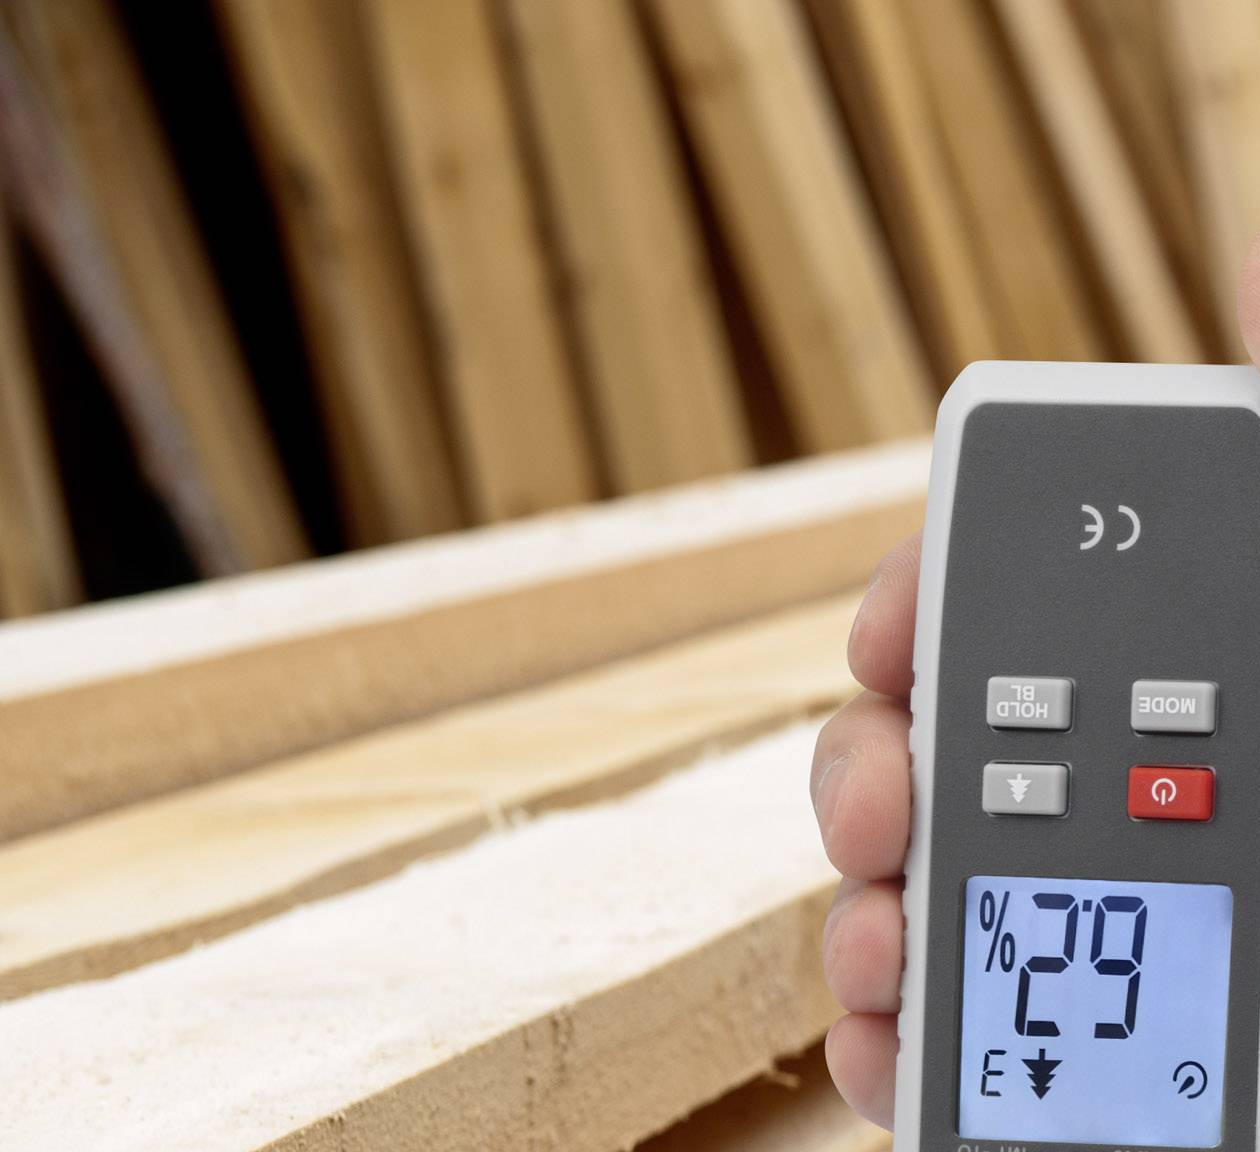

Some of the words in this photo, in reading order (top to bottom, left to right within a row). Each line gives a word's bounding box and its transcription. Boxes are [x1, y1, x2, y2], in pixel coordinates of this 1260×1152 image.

[1011, 685, 1036, 701] BL
[996, 701, 1049, 719] HOLD
[1138, 696, 1196, 715] MODE
[980, 1049, 1007, 1097] 3
